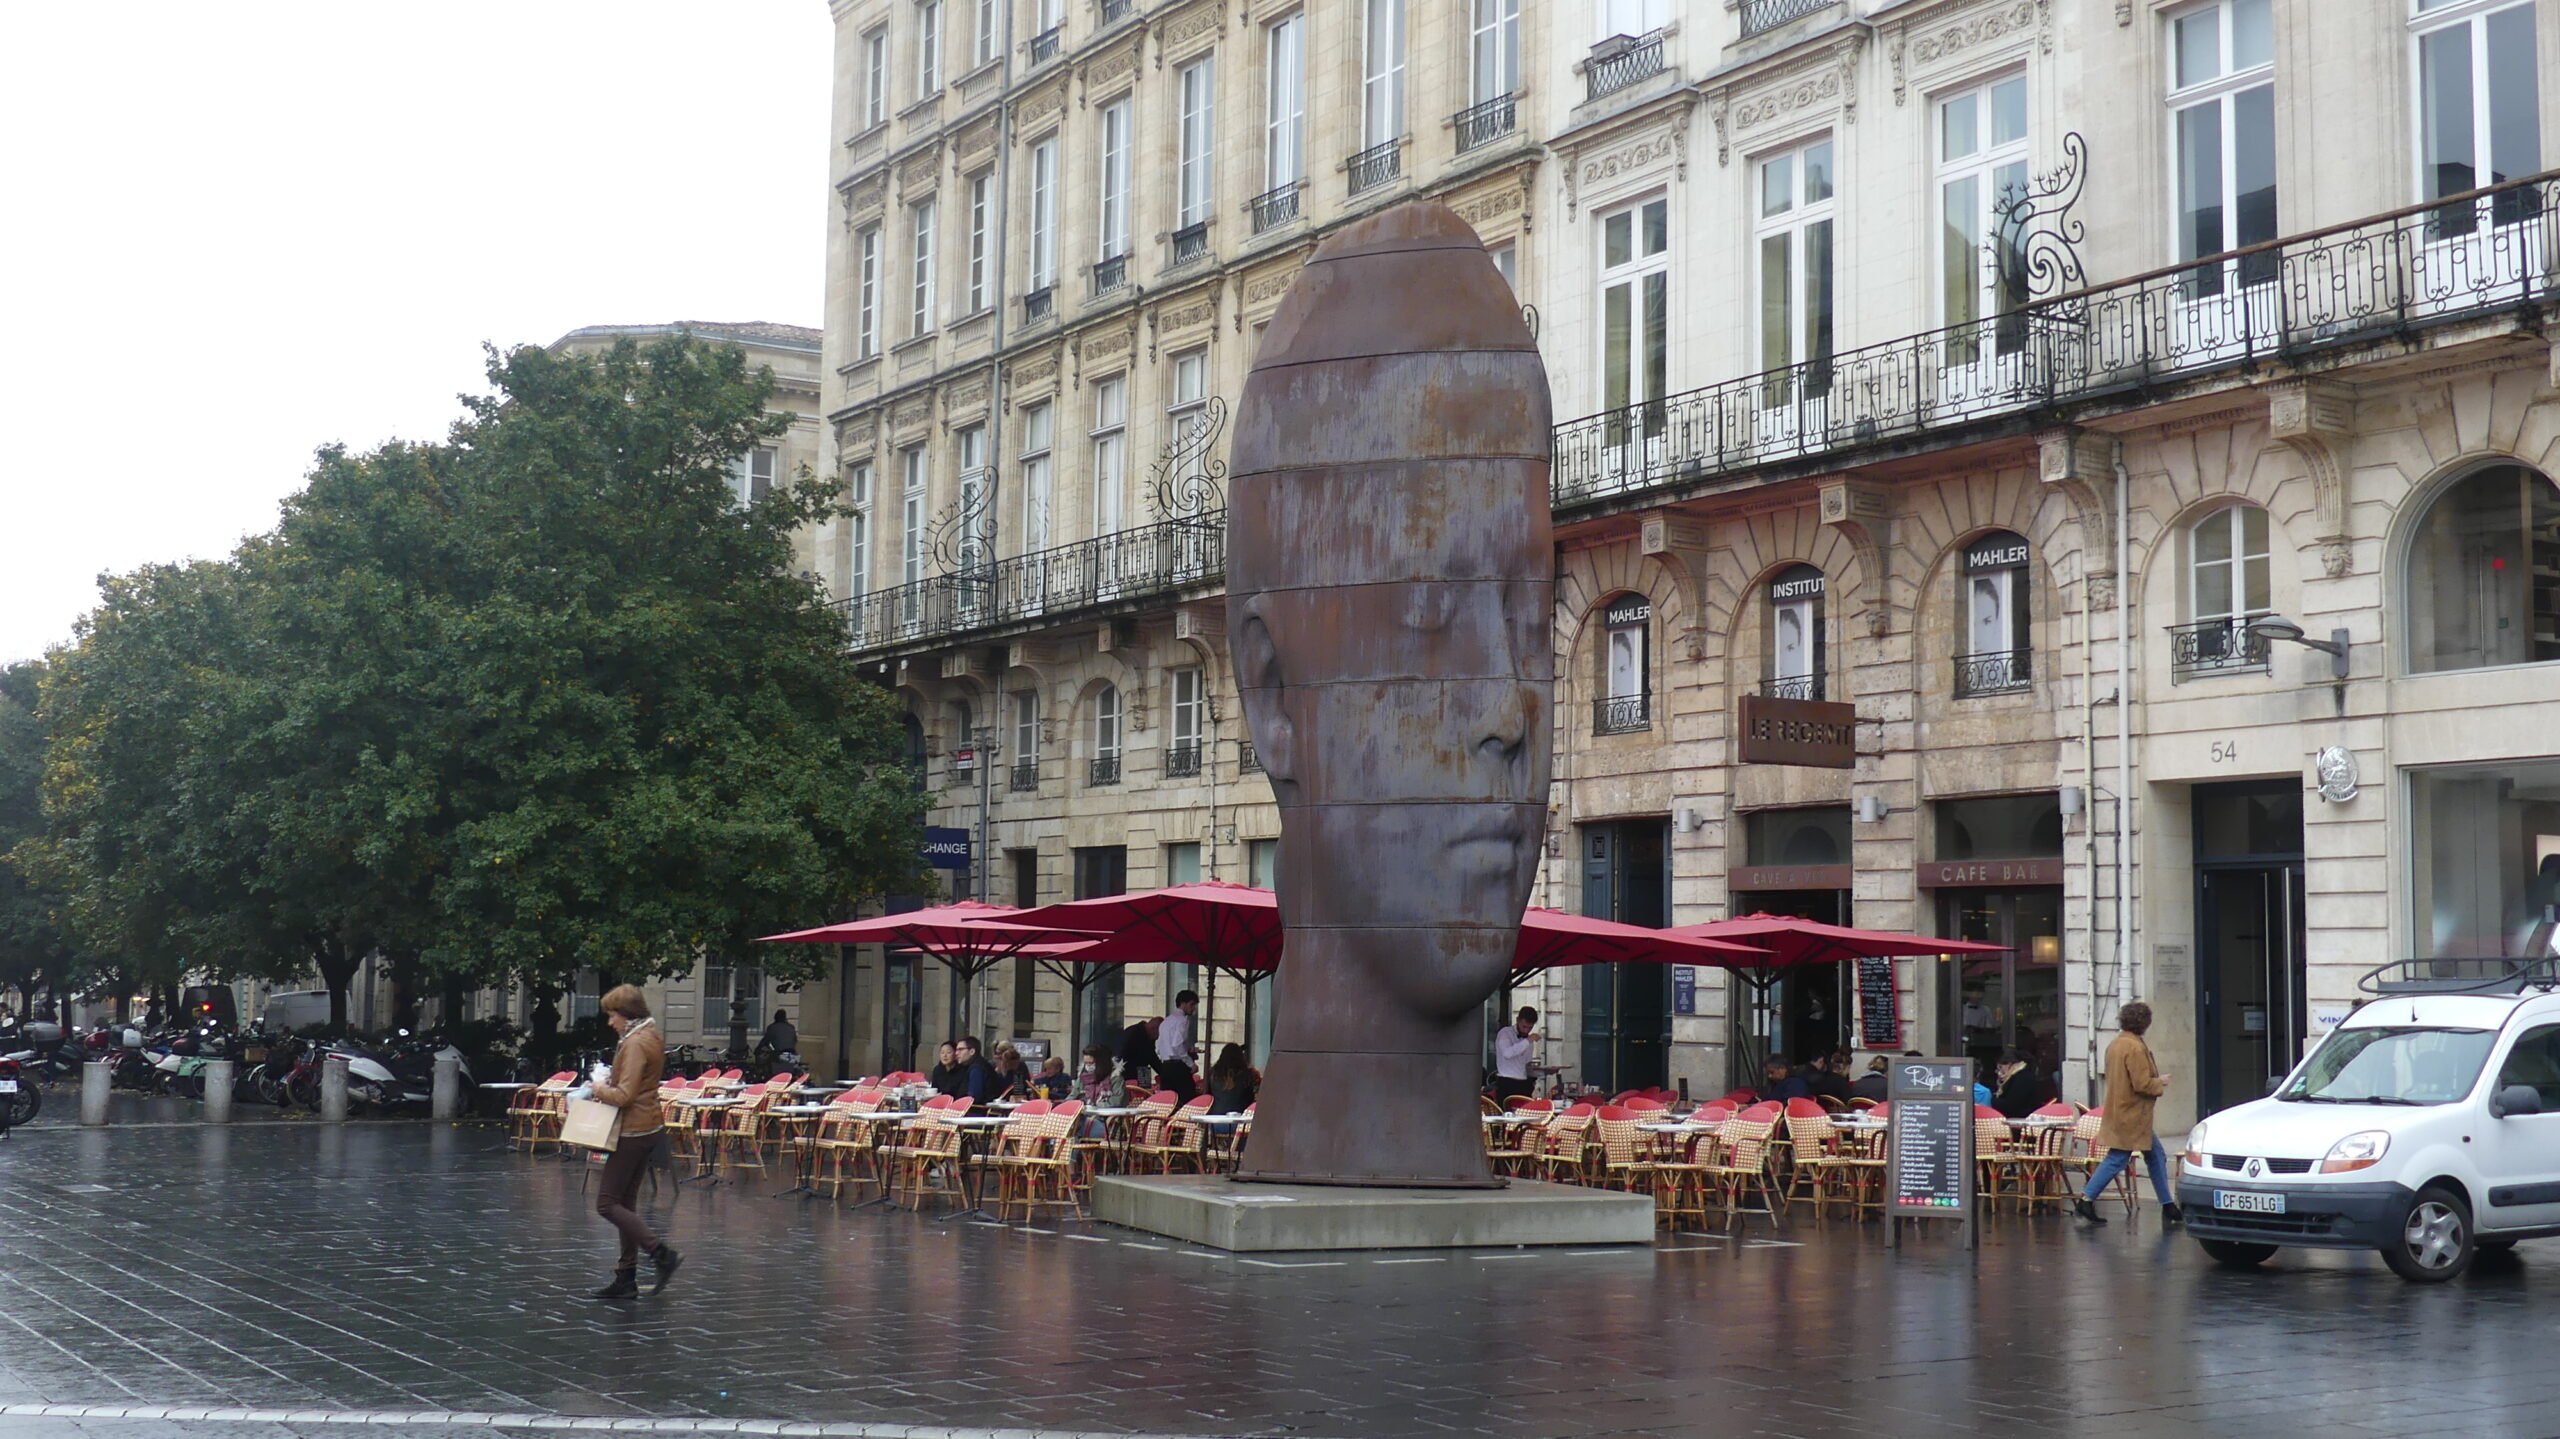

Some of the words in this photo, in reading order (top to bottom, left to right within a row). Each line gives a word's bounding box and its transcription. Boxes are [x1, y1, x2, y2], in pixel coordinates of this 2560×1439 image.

[1969, 546, 2027, 568] MAHLER
[1773, 577, 1825, 598] INSTITUT
[1609, 606, 1650, 624] MAHLER
[1751, 719, 1770, 740] LE
[1778, 721, 1851, 745] REGENT
[2211, 740, 2237, 763] 54
[1941, 866, 1987, 882] CAFE
[2003, 865, 2038, 880] BAR
